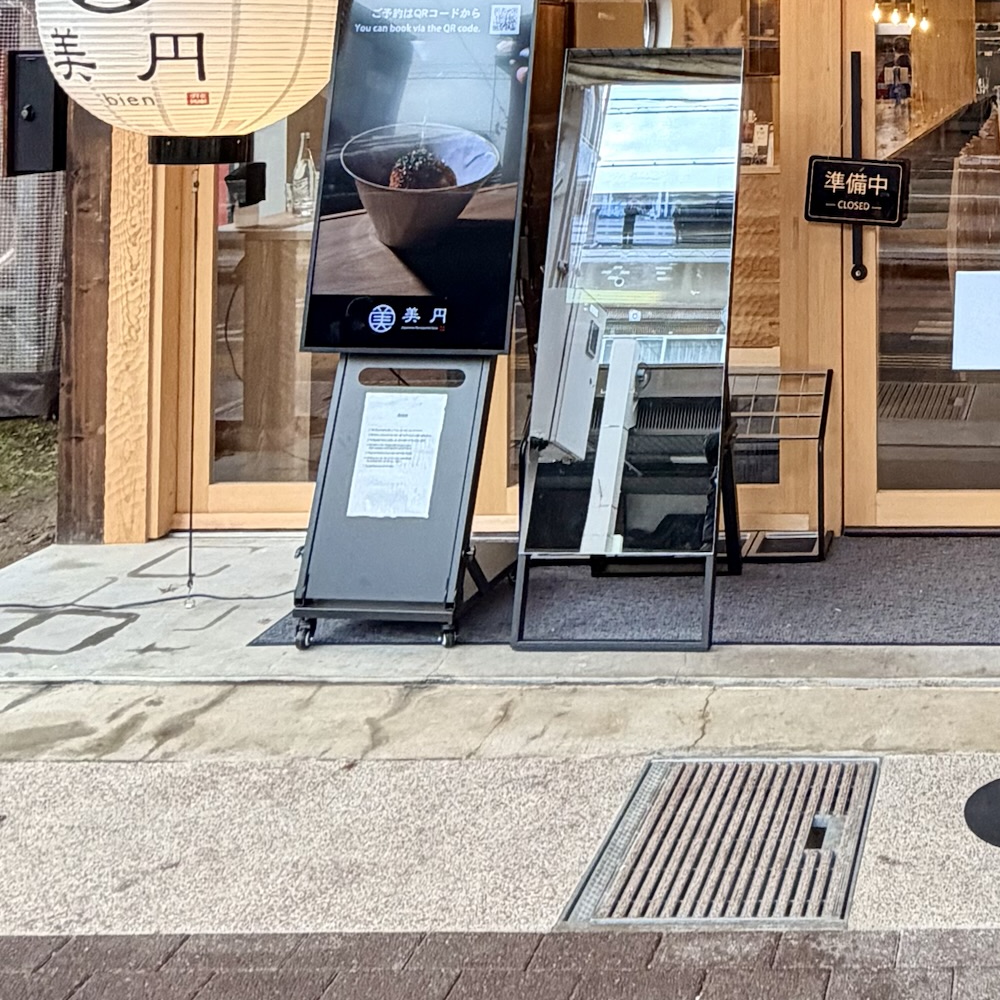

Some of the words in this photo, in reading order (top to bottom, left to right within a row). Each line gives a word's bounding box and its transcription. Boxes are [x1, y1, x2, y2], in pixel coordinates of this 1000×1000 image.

[371, 7, 480, 20] ご予約はQRコードから
[354, 23, 371, 33] You
[372, 25, 388, 33] can
[389, 23, 413, 33] book
[413, 23, 426, 33] via
[427, 24, 442, 33] the
[443, 24, 456, 34] QR
[457, 23, 481, 33] code.
[103, 93, 156, 107] bien
[824, 170, 888, 197] 準備中
[837, 200, 870, 211] CLOSED
